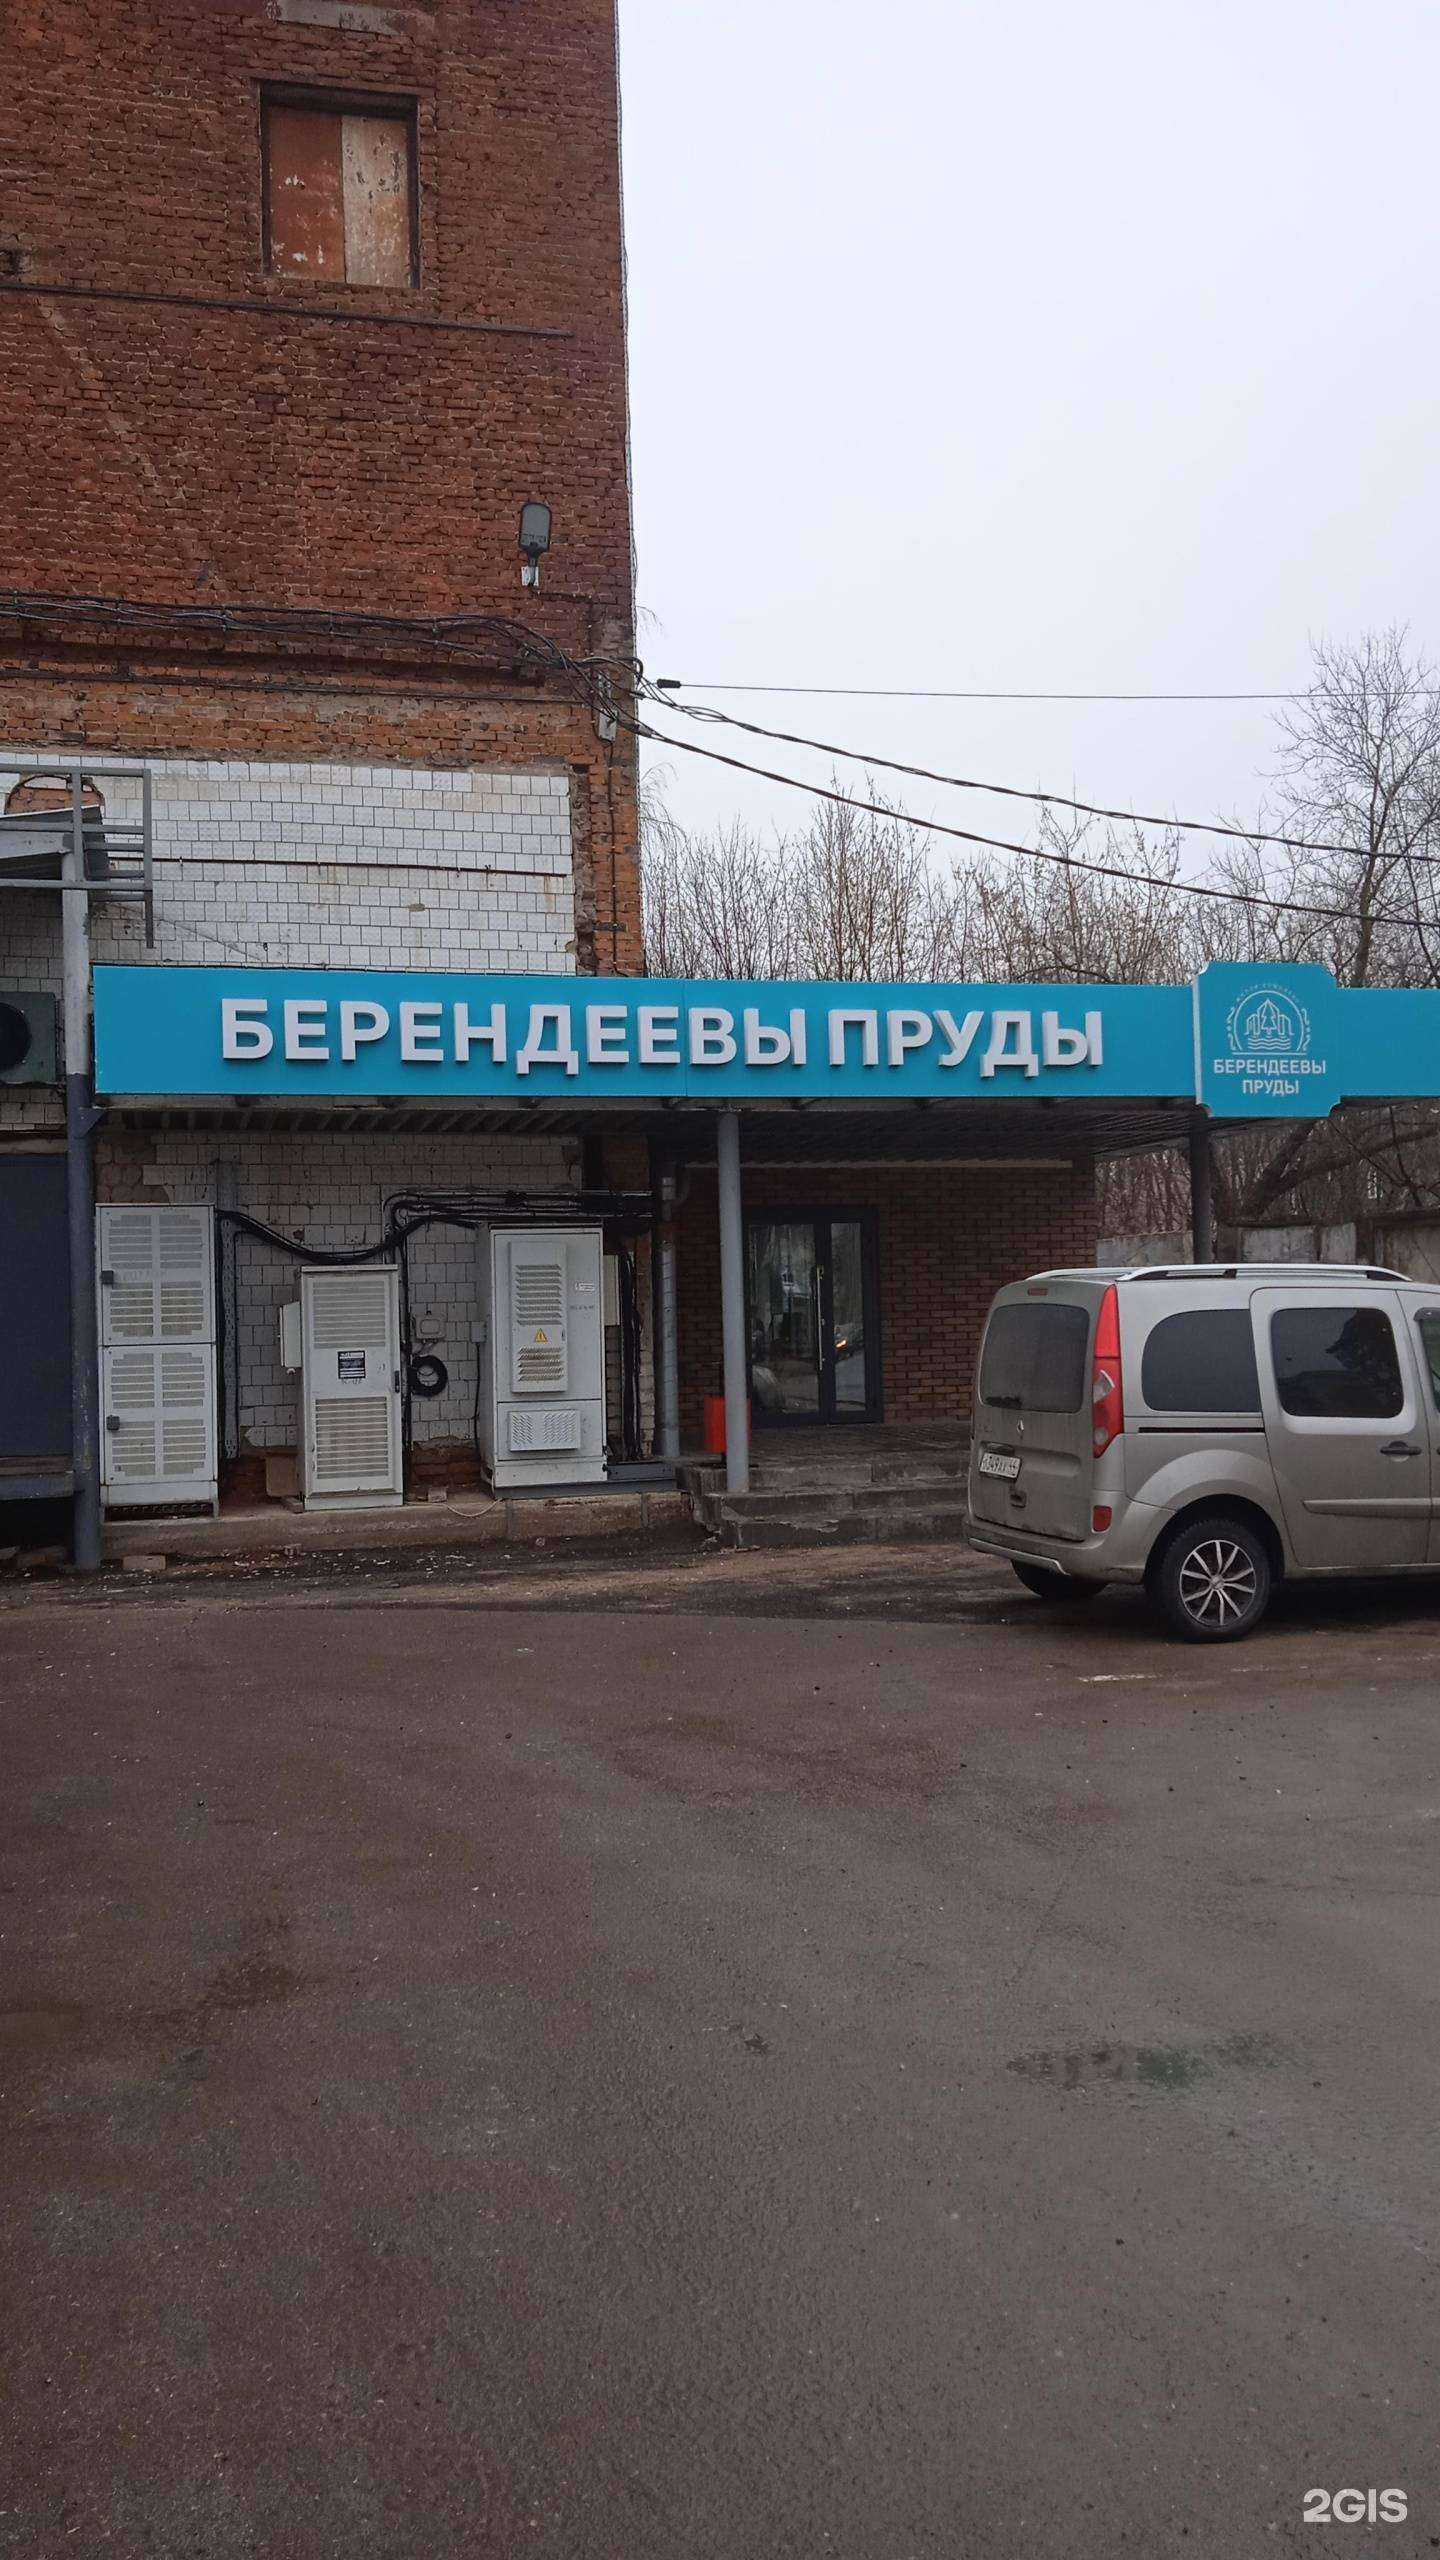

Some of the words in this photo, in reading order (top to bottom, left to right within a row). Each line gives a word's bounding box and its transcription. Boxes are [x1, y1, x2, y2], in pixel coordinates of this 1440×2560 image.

[221, 998, 806, 1076] БЕРЕНДЕЕВЫ
[828, 1008, 1103, 1078] ПРУДЫ
[1213, 1059, 1326, 1076] БЕРЕНДЕЕВЫ
[1242, 1079, 1300, 1096] ПРУДЫ
